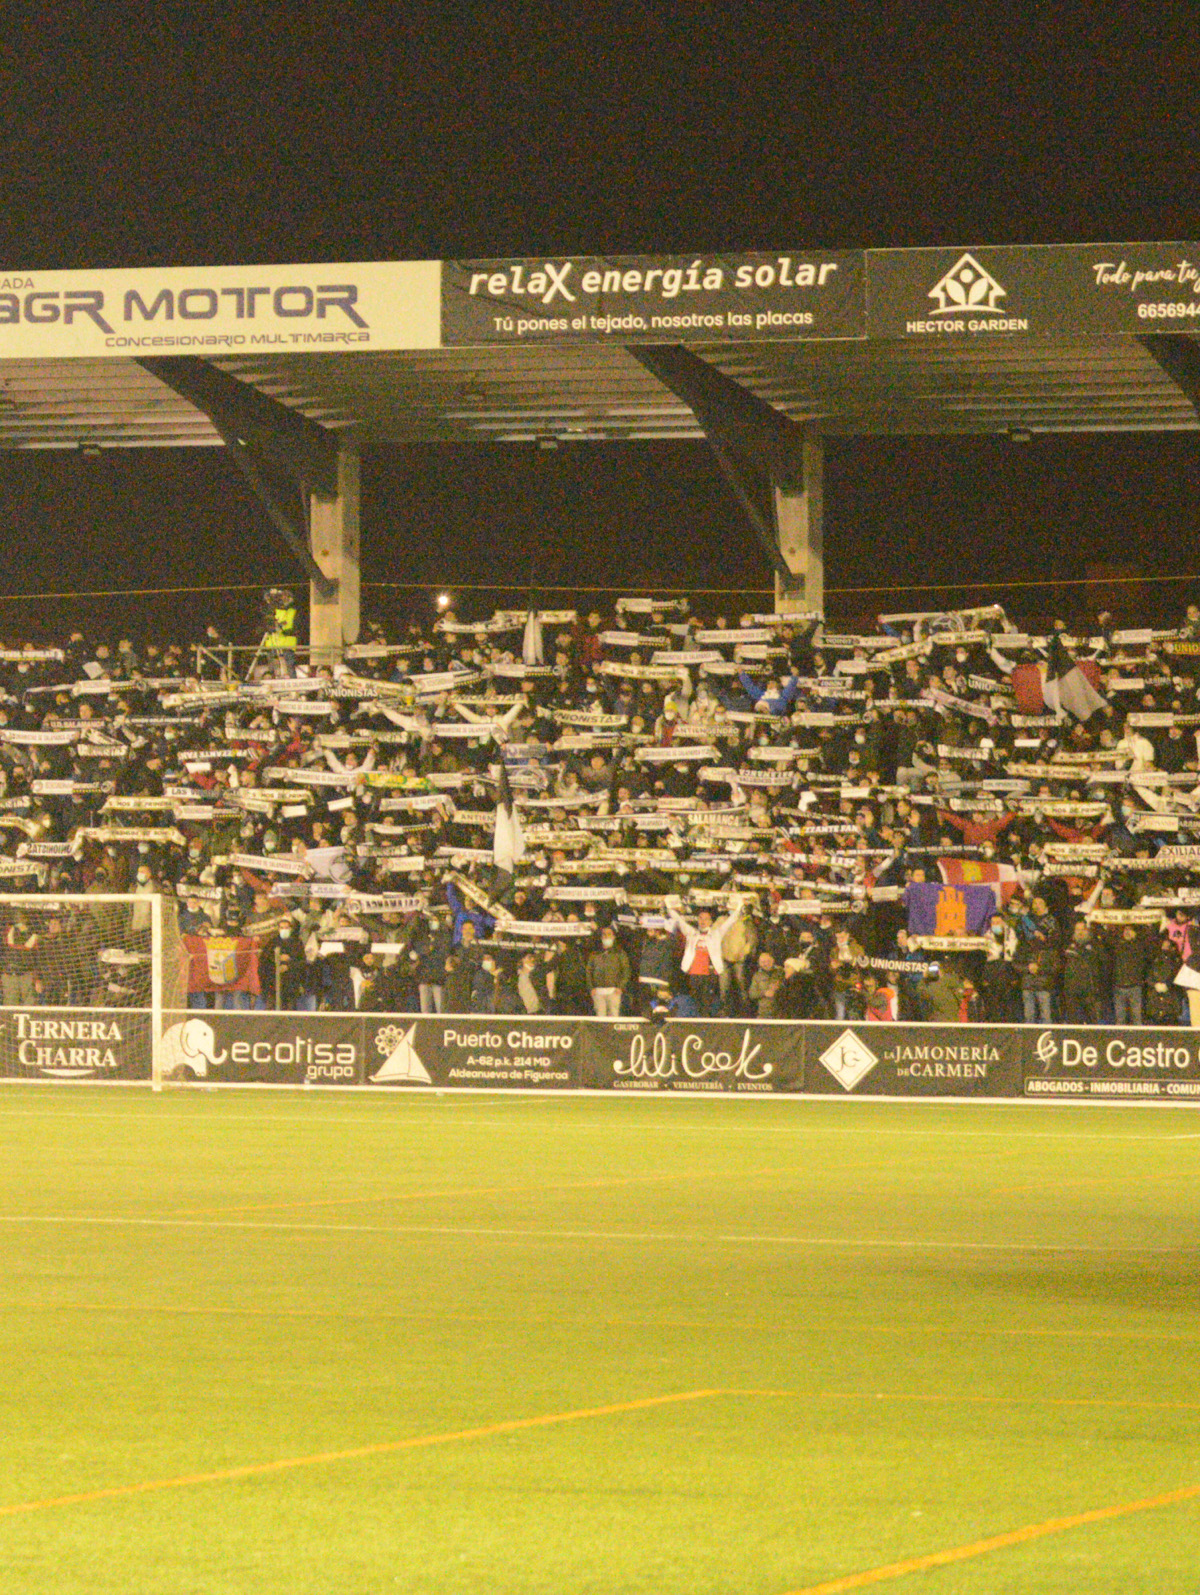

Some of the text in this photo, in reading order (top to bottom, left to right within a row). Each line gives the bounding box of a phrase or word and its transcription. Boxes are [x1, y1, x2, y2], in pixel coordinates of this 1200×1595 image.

[469, 257, 838, 304] relaX energía solar
[494, 316, 513, 332] Tú
[517, 318, 568, 335] pones
[571, 315, 587, 330] el
[651, 312, 724, 328] nosotros
[727, 311, 752, 326] las
[756, 310, 814, 330] placas
[906, 318, 1028, 333] HECTOR GARDEN
[871, 957, 929, 972] UNIONISTAS
[13, 1013, 122, 1041] TERNERA
[443, 1029, 573, 1049] Puerto Charro
[18, 1040, 118, 1067] CHARRA
[230, 1037, 357, 1065] ecotisa
[894, 1044, 1000, 1063] JAMONERÍA
[1062, 1039, 1191, 1068] De Castro
[533, 1057, 551, 1067] MD
[909, 1062, 987, 1077] CARMEN
[307, 1065, 354, 1079] grupo
[448, 1068, 569, 1082] Aldeanueva de Figueroa
[1027, 1080, 1084, 1093] ABOGADOS
[1090, 1082, 1160, 1094] INMOBILIARIA
